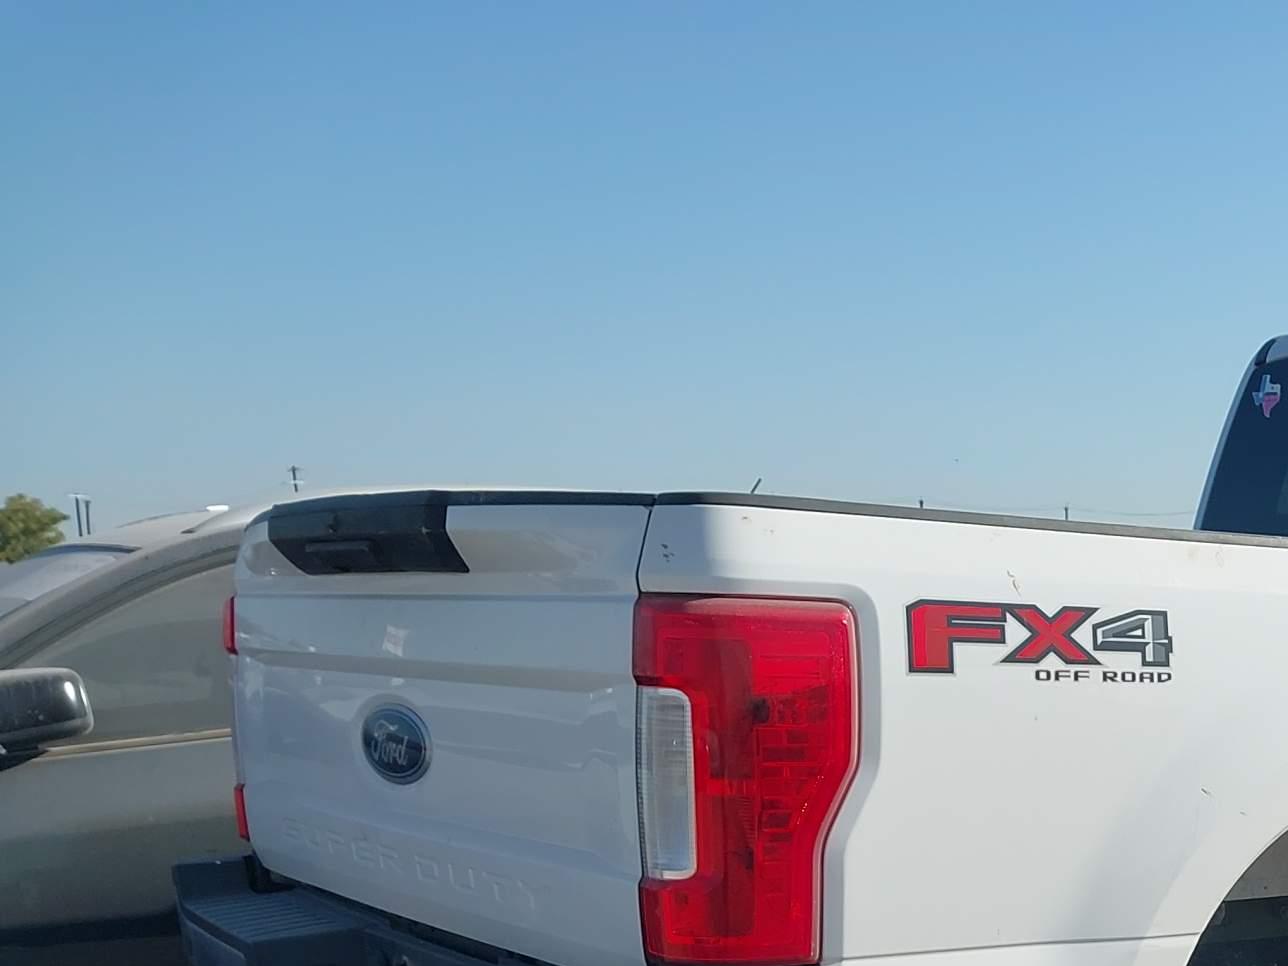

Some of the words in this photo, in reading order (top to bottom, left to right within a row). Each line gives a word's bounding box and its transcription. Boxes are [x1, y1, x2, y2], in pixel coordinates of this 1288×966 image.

[904, 599, 1173, 674] FX4
[1034, 669, 1091, 682] OFF
[1102, 671, 1173, 684] ROAD
[371, 719, 409, 766] Ford
[281, 816, 401, 872] SUPER
[414, 854, 550, 911] DUTY
